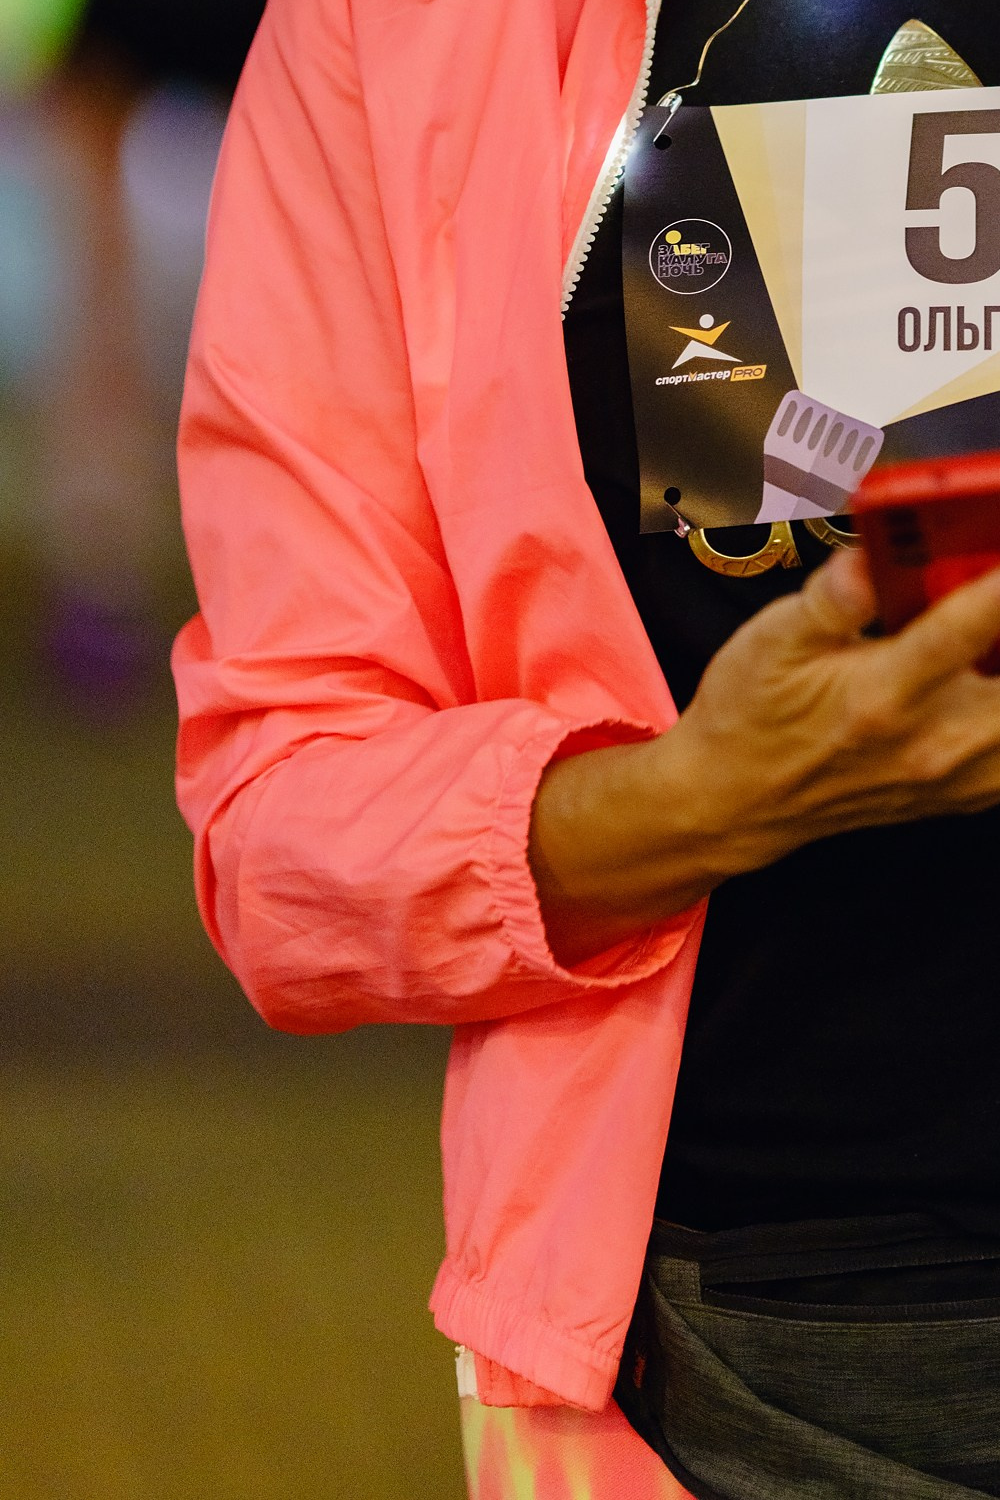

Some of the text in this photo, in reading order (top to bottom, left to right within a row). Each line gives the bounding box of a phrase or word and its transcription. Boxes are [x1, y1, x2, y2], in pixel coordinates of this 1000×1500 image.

[658, 243, 711, 256] ЗАБЕГ
[658, 252, 728, 267] КАЛУГА
[658, 264, 705, 278] НОЧЬ
[733, 367, 763, 380] PRO
